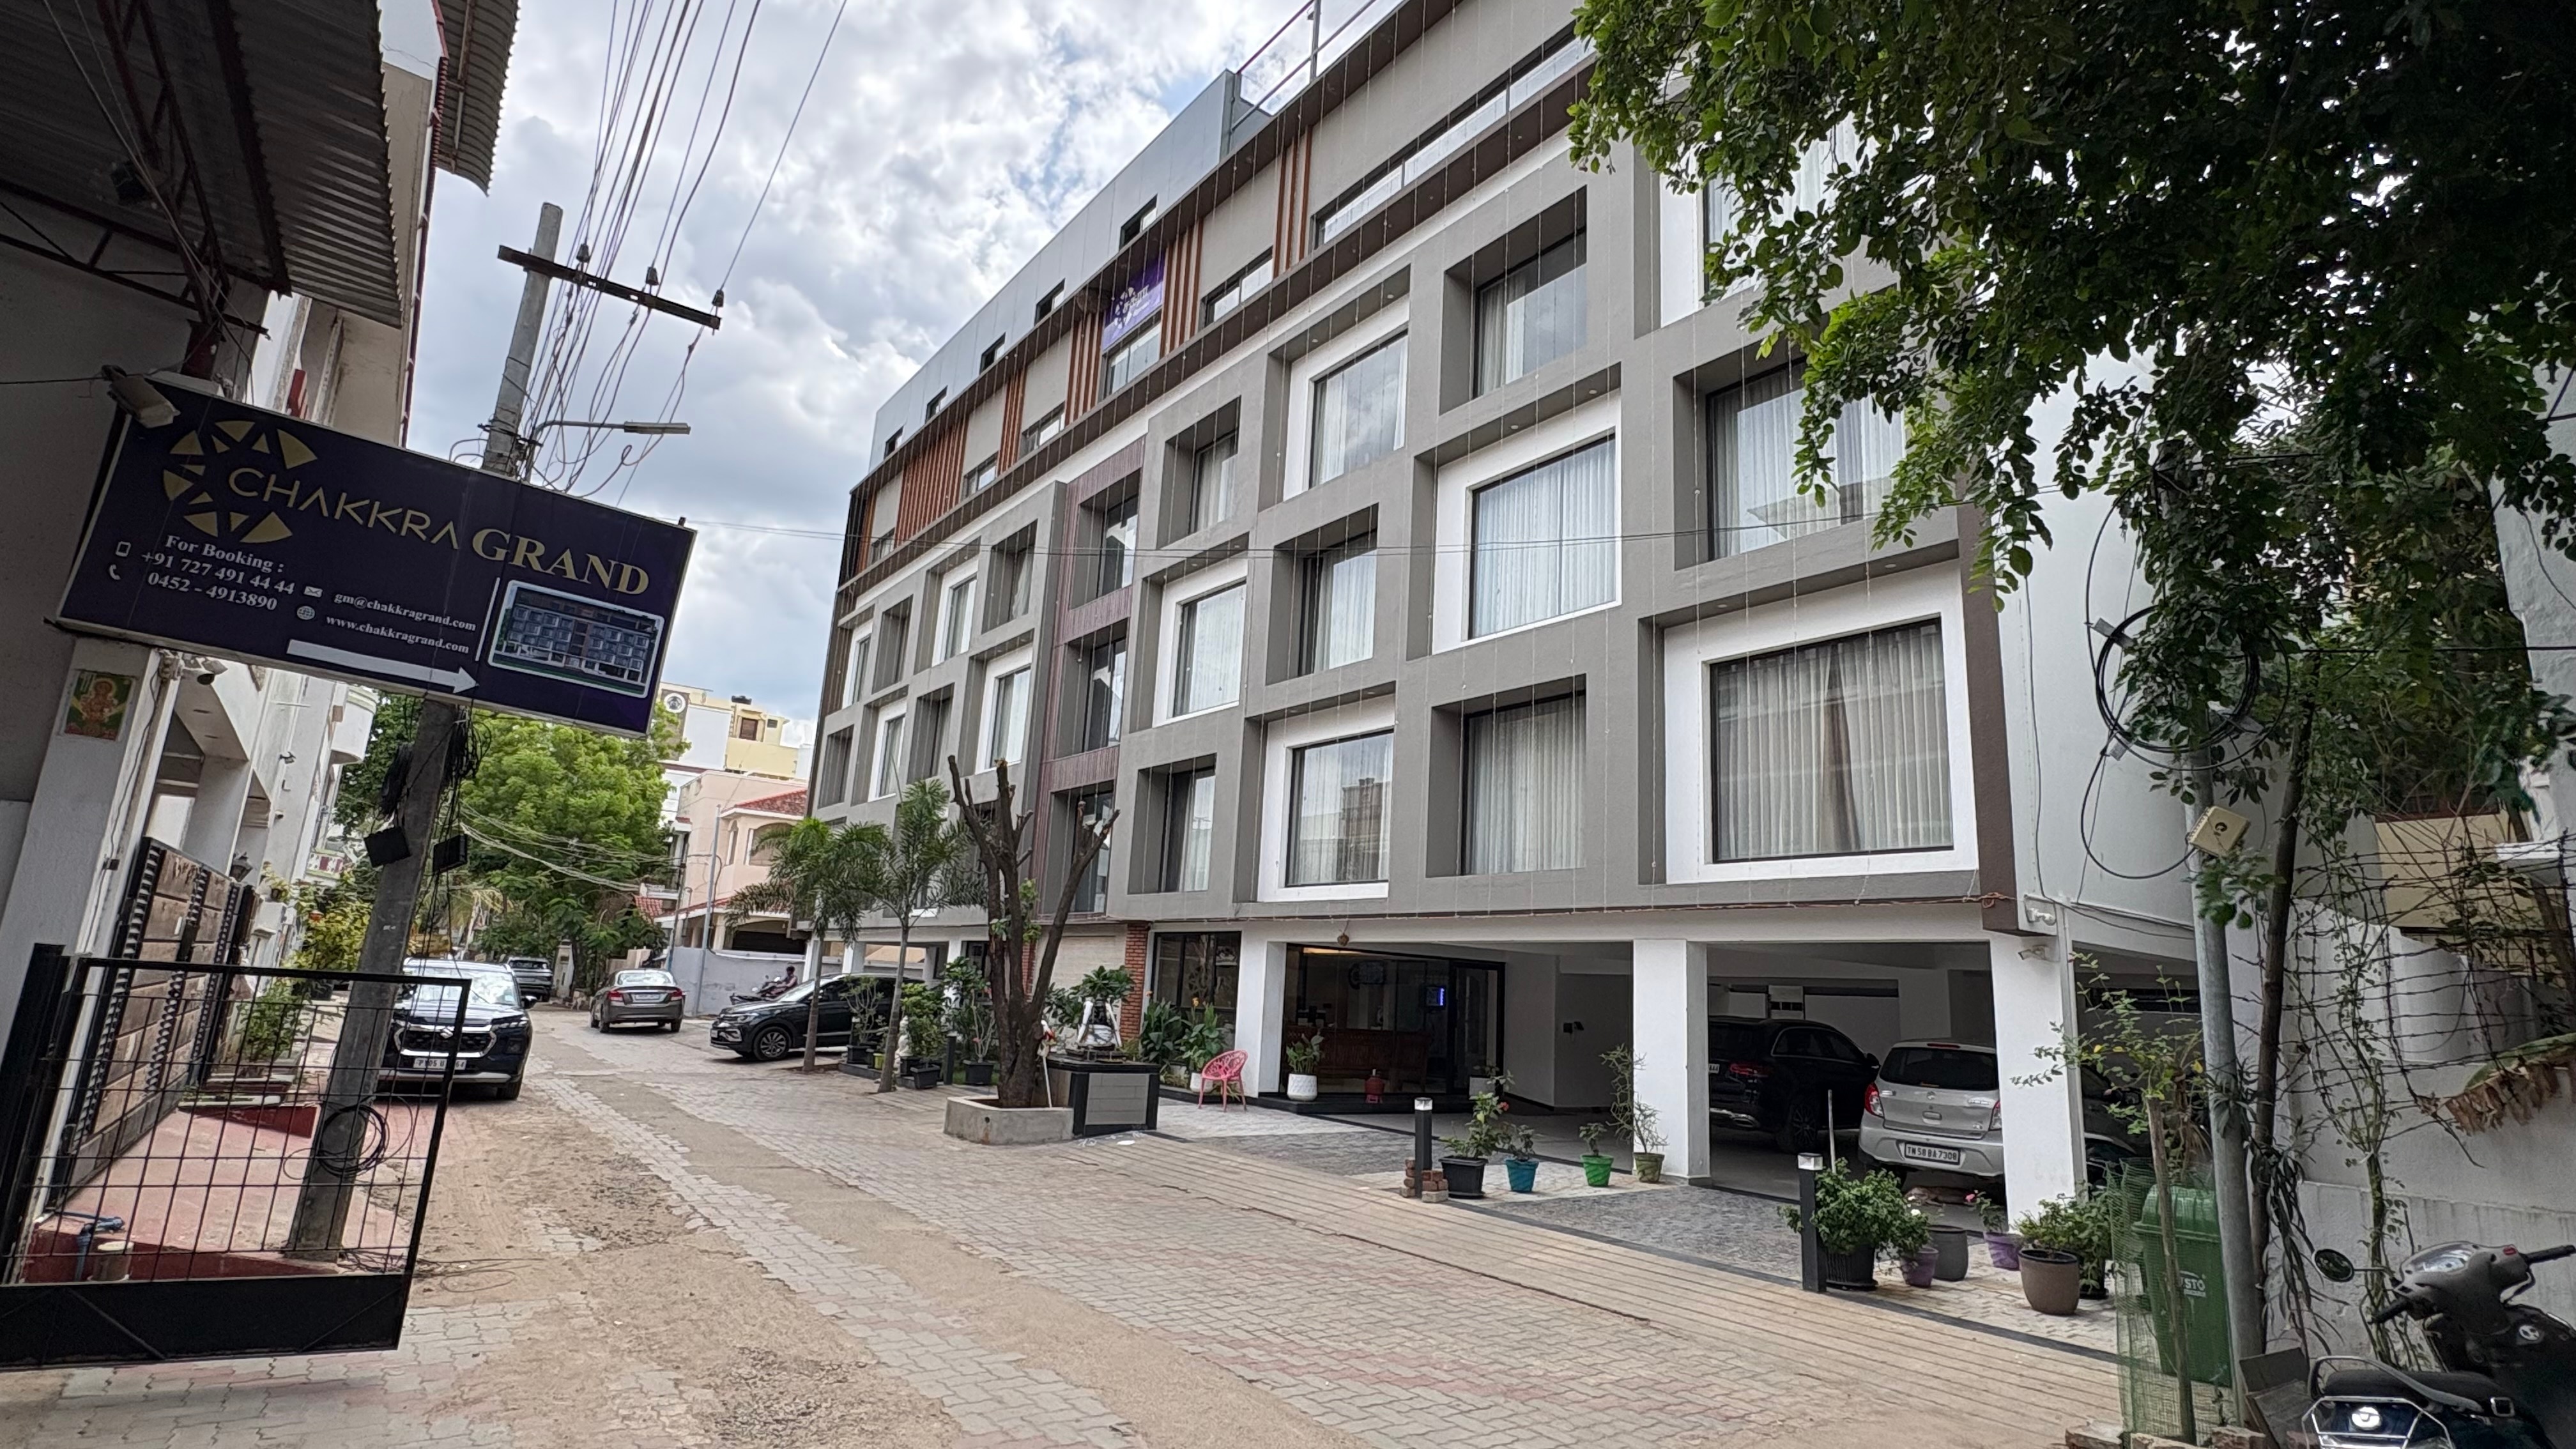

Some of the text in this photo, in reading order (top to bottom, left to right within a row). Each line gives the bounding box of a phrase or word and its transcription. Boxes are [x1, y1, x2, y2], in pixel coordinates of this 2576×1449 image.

[229, 467, 650, 595] CHAKKRA GRAND
[141, 551, 296, 595] +91 727 491 44 44
[165, 535, 199, 553] For
[202, 543, 273, 574] Booking
[148, 572, 191, 592] 0452
[205, 585, 277, 611] 4913890
[334, 594, 477, 631] gm@chakkragrand.com
[326, 615, 470, 654] www.chakkragrand.com
